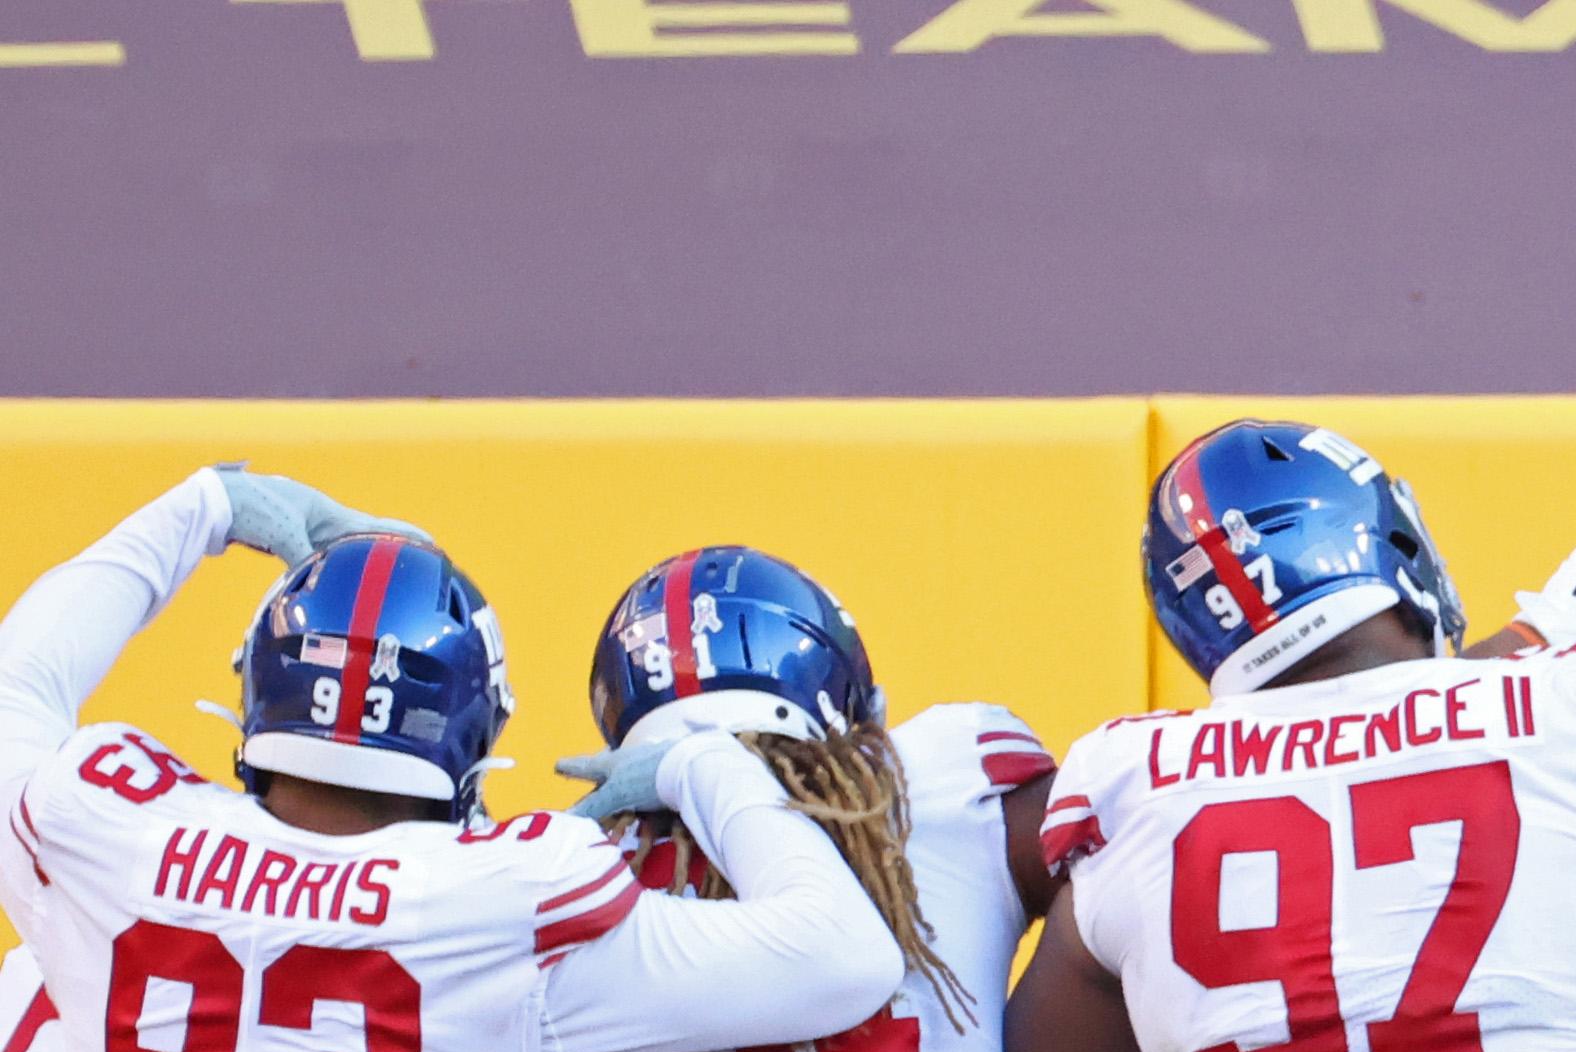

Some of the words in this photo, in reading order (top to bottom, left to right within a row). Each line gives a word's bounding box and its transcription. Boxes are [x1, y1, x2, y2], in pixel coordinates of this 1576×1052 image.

[1204, 553, 1283, 631] 97
[643, 633, 718, 692] 91
[310, 676, 394, 734] 93
[1149, 678, 1485, 790] LAWRENCE
[1501, 675, 1536, 738] II
[154, 827, 400, 927] HARRIS
